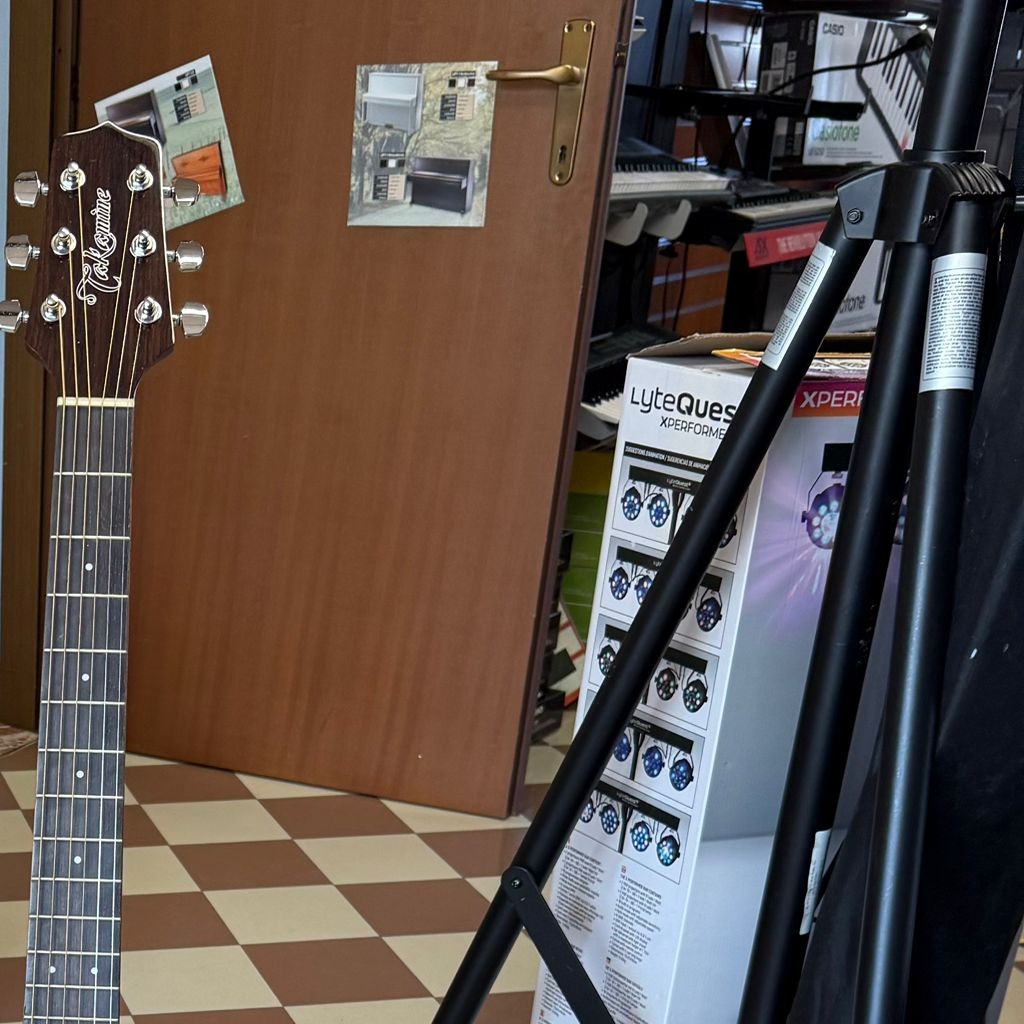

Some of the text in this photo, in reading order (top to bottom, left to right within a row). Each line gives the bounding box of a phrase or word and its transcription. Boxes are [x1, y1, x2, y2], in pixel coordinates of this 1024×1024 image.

[822, 22, 844, 36] CASIO
[76, 187, 122, 306] Takamine
[630, 386, 736, 424] LyteQues
[800, 390, 865, 408] XPERF
[660, 416, 726, 440] XPERFORME
